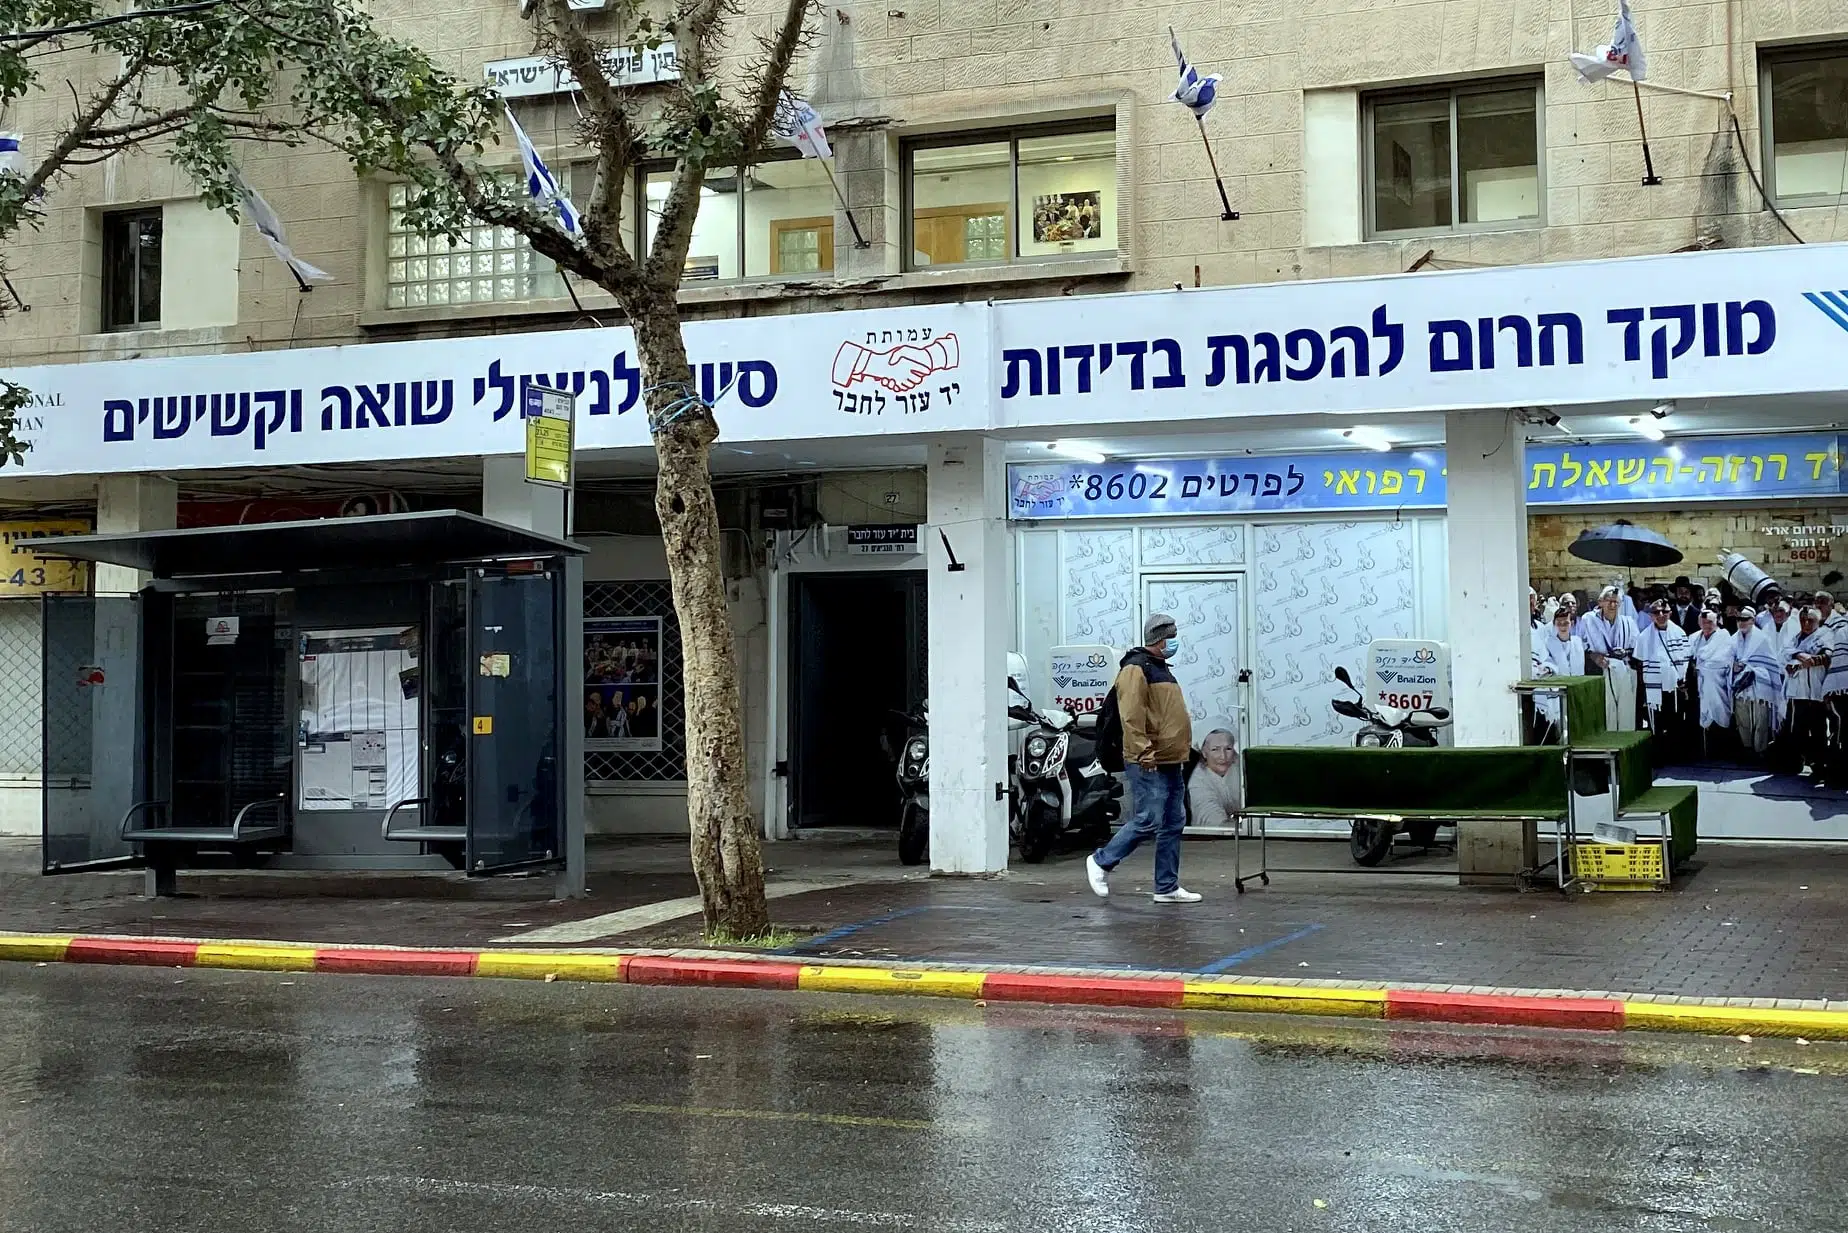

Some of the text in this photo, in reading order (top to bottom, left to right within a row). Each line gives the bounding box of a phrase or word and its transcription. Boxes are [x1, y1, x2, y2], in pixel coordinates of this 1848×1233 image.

[866, 328, 932, 344] עמותת
[1001, 300, 1776, 399] מוקד חרום להפגת בדידות
[688, 360, 778, 408] סיו
[833, 383, 960, 415] יד עזר לחבר
[104, 389, 302, 450] וקשישים
[321, 379, 454, 431] שואה
[1181, 464, 1305, 498] לפרטים
[1323, 467, 1427, 495] רפואי
[1528, 452, 1788, 489] רוזה-השאלת
[886, 494, 897, 503] 27
[900, 528, 915, 539] בית
[477, 719, 484, 732] 4
